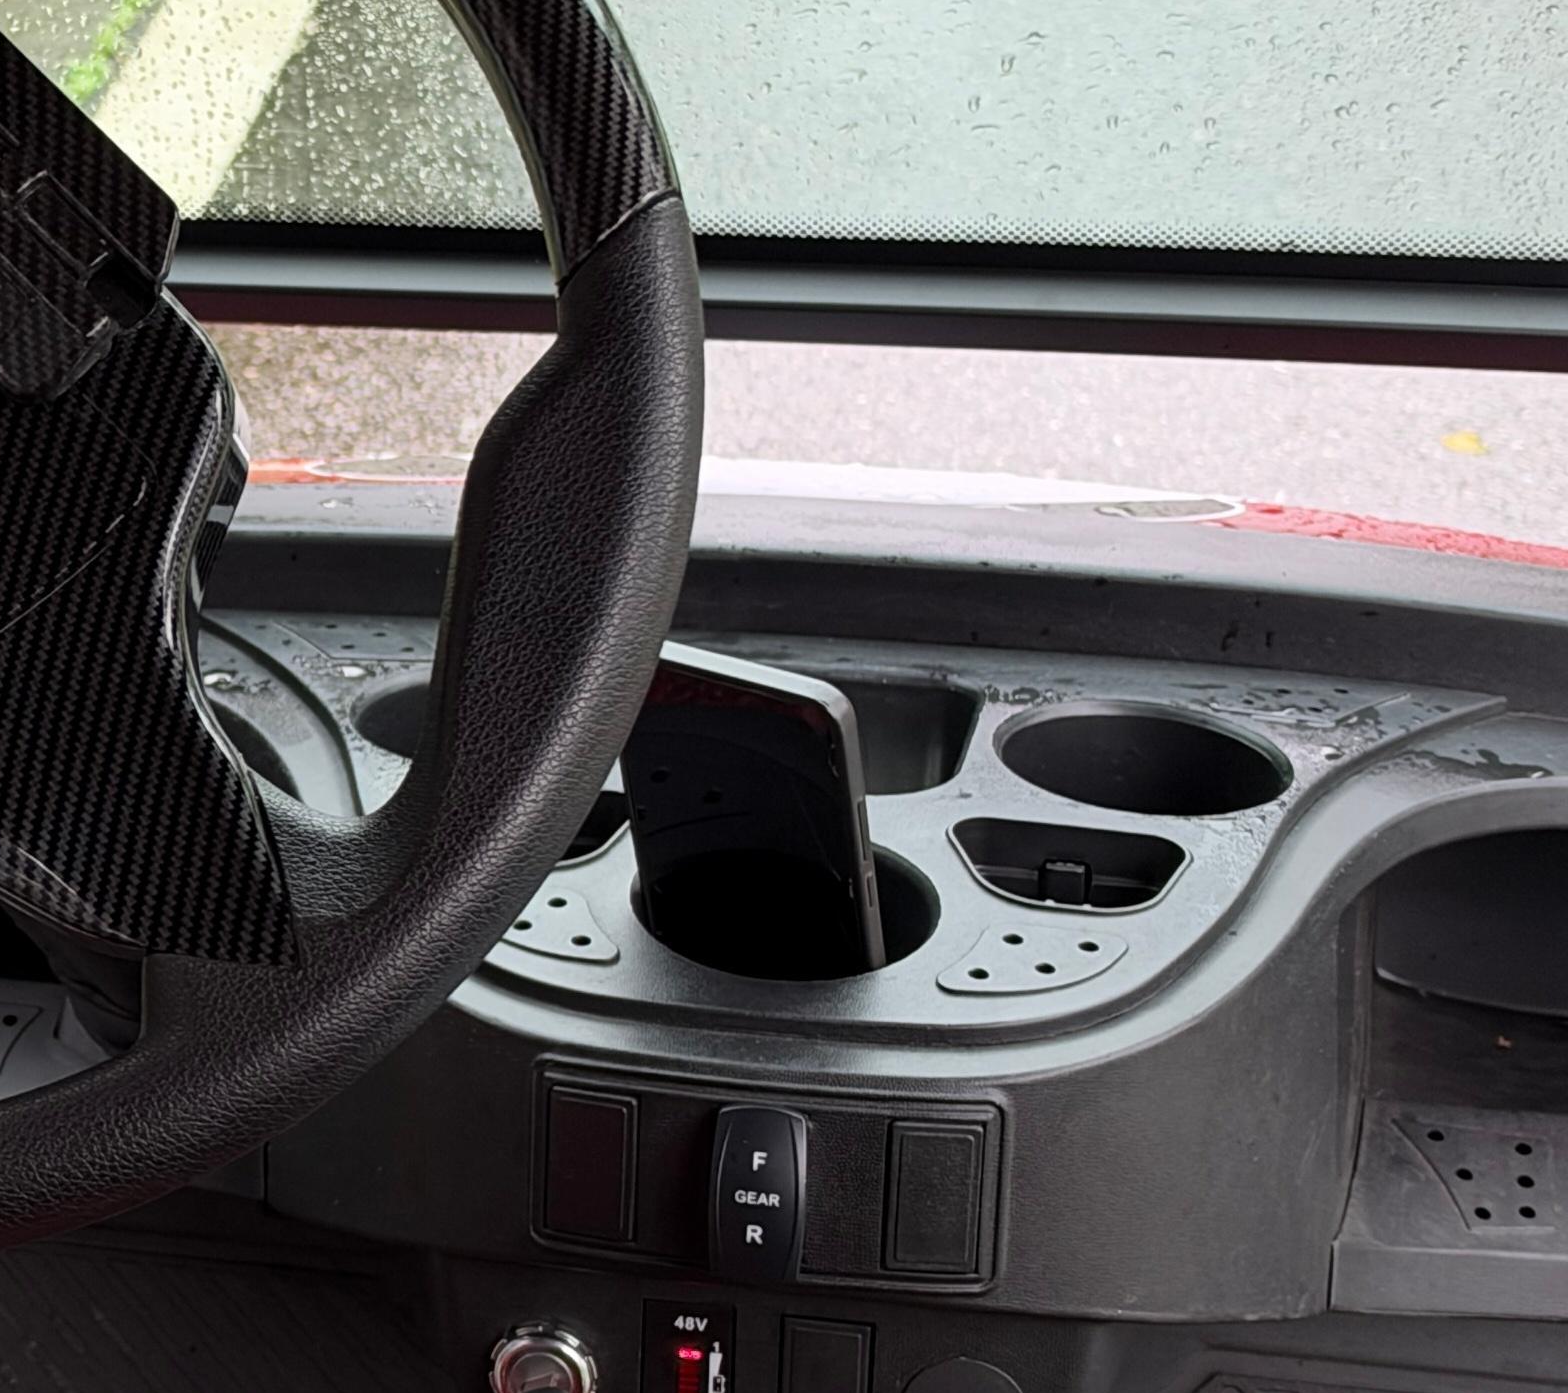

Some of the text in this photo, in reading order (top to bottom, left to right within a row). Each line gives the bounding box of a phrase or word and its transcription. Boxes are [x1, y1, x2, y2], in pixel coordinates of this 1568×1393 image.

[752, 1151, 768, 1172] F
[734, 1189, 780, 1208] GEAR
[745, 1224, 763, 1245] R
[673, 1315, 708, 1332] 48V
[713, 1341, 720, 1353] 1
